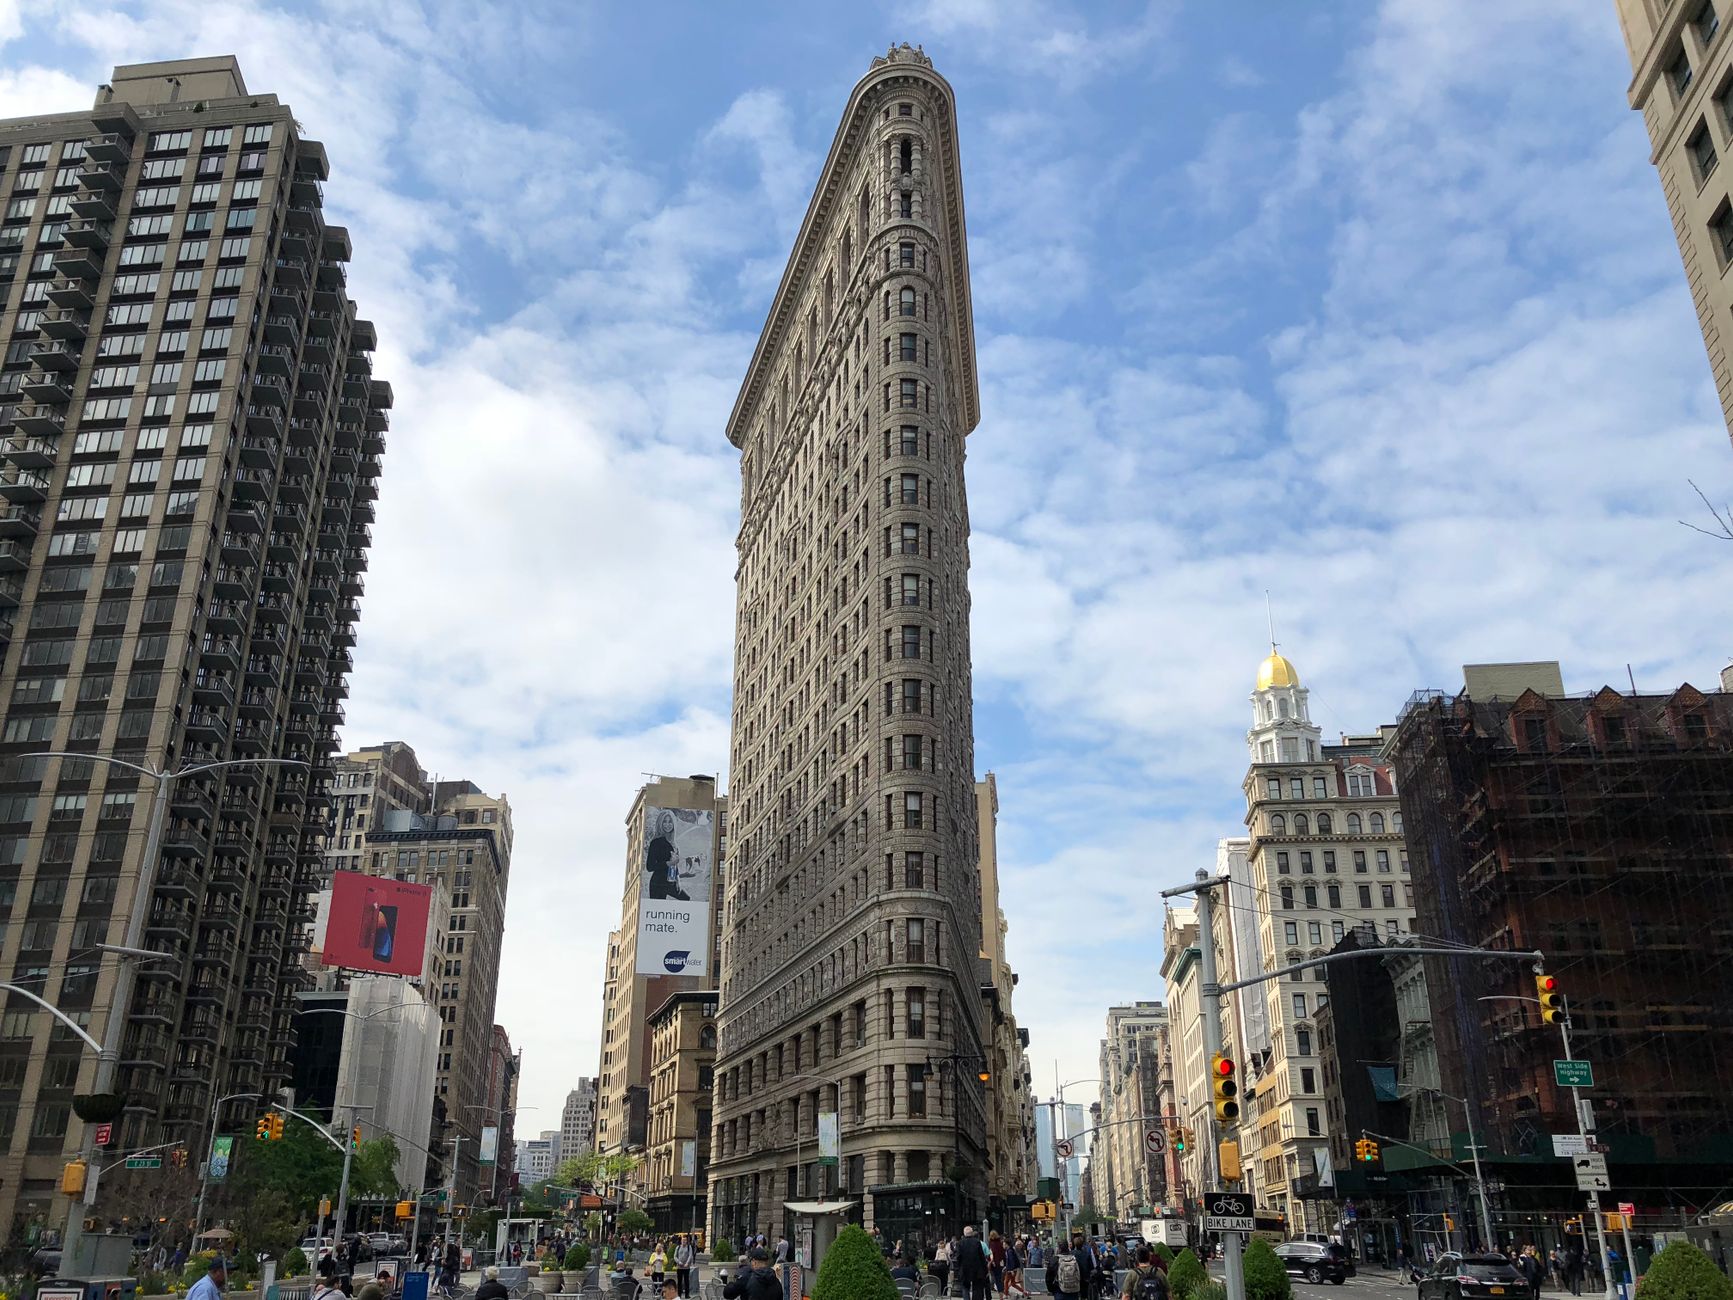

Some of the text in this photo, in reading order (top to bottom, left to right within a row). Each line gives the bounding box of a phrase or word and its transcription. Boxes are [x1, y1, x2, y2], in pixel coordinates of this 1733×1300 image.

[645, 910, 690, 923] running
[645, 923, 678, 933] mate.
[1207, 1218, 1253, 1229] BIKE LANE
